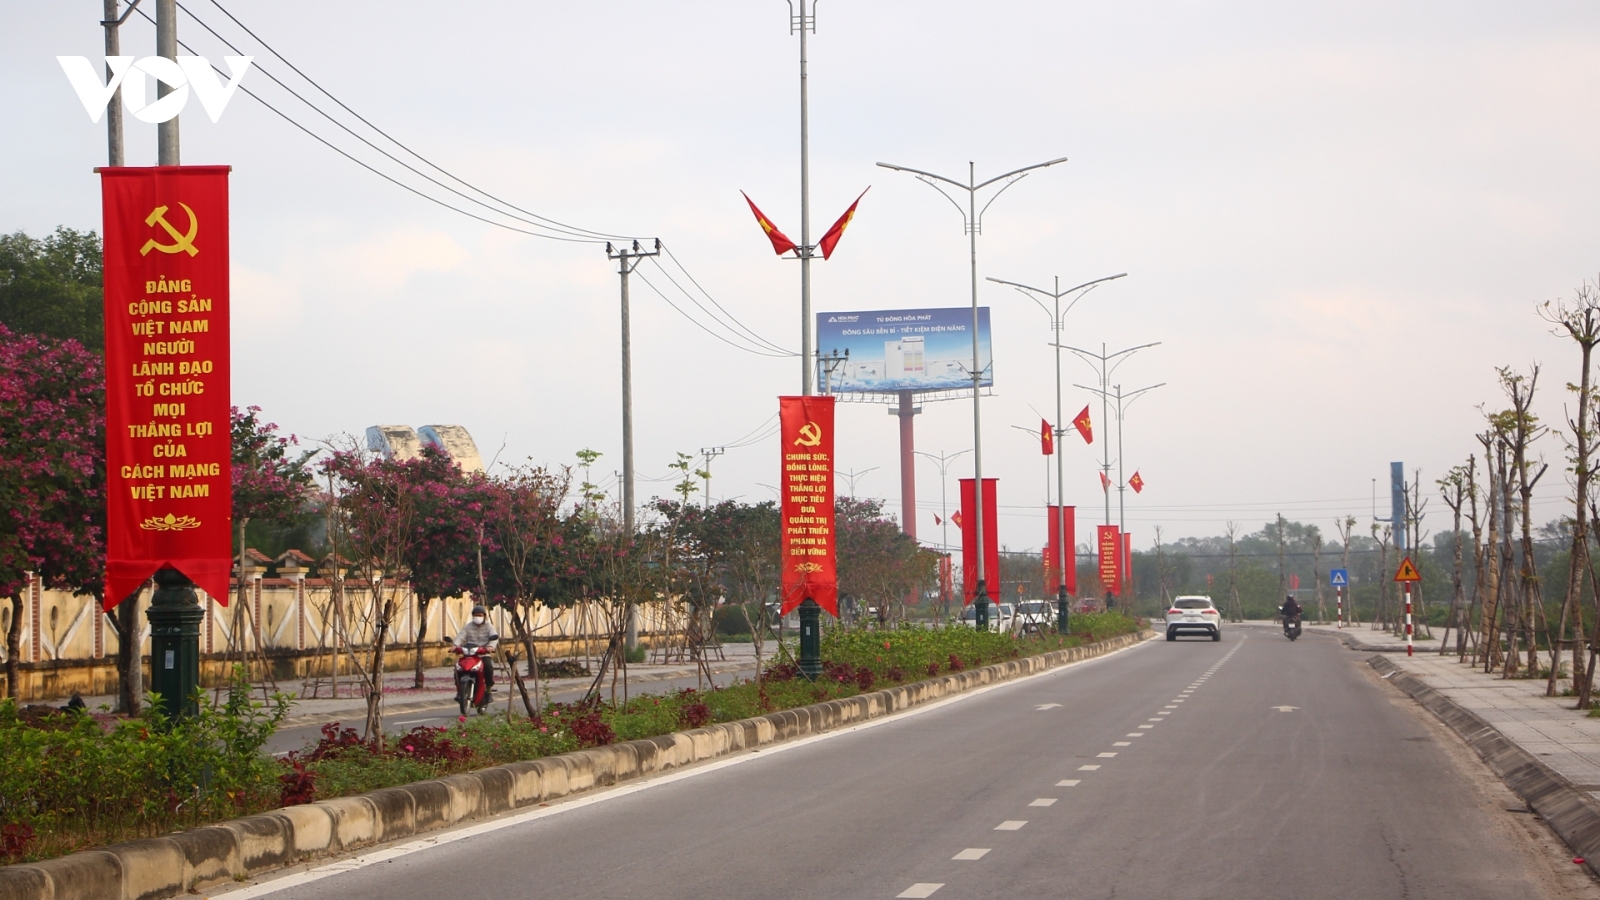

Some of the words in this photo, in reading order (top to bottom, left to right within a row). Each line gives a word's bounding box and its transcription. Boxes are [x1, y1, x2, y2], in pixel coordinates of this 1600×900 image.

[145, 275, 192, 294] ĐẢNG
[128, 299, 172, 317] CỘNG
[177, 294, 212, 313] SẢN
[131, 319, 164, 337] VIỆT
[169, 319, 208, 334] NAM
[143, 338, 195, 355] NGƯỜI
[132, 361, 174, 376] LÃNH
[179, 360, 213, 377] ĐẠO
[135, 379, 155, 397] TỔ
[159, 379, 204, 395] CHỨC
[153, 403, 185, 419] MỌI
[128, 420, 181, 437] THẮNG
[186, 421, 212, 438] LỢI
[153, 439, 187, 457] CỦA
[786, 453, 811, 461] CHUNG
[121, 463, 164, 479] CÁCH
[169, 463, 220, 480] MẠNG
[789, 474, 809, 483] THỰC
[810, 474, 827, 483] HIỆN
[131, 483, 165, 502] VIỆT
[170, 484, 209, 498] NAM
[815, 485, 827, 494] LỢI
[791, 495, 808, 504] MỤC
[789, 515, 815, 525] QUẢNG
[816, 517, 827, 525] TRỊ
[787, 526, 807, 535] PHÁT
[817, 536, 827, 545] VÀ
